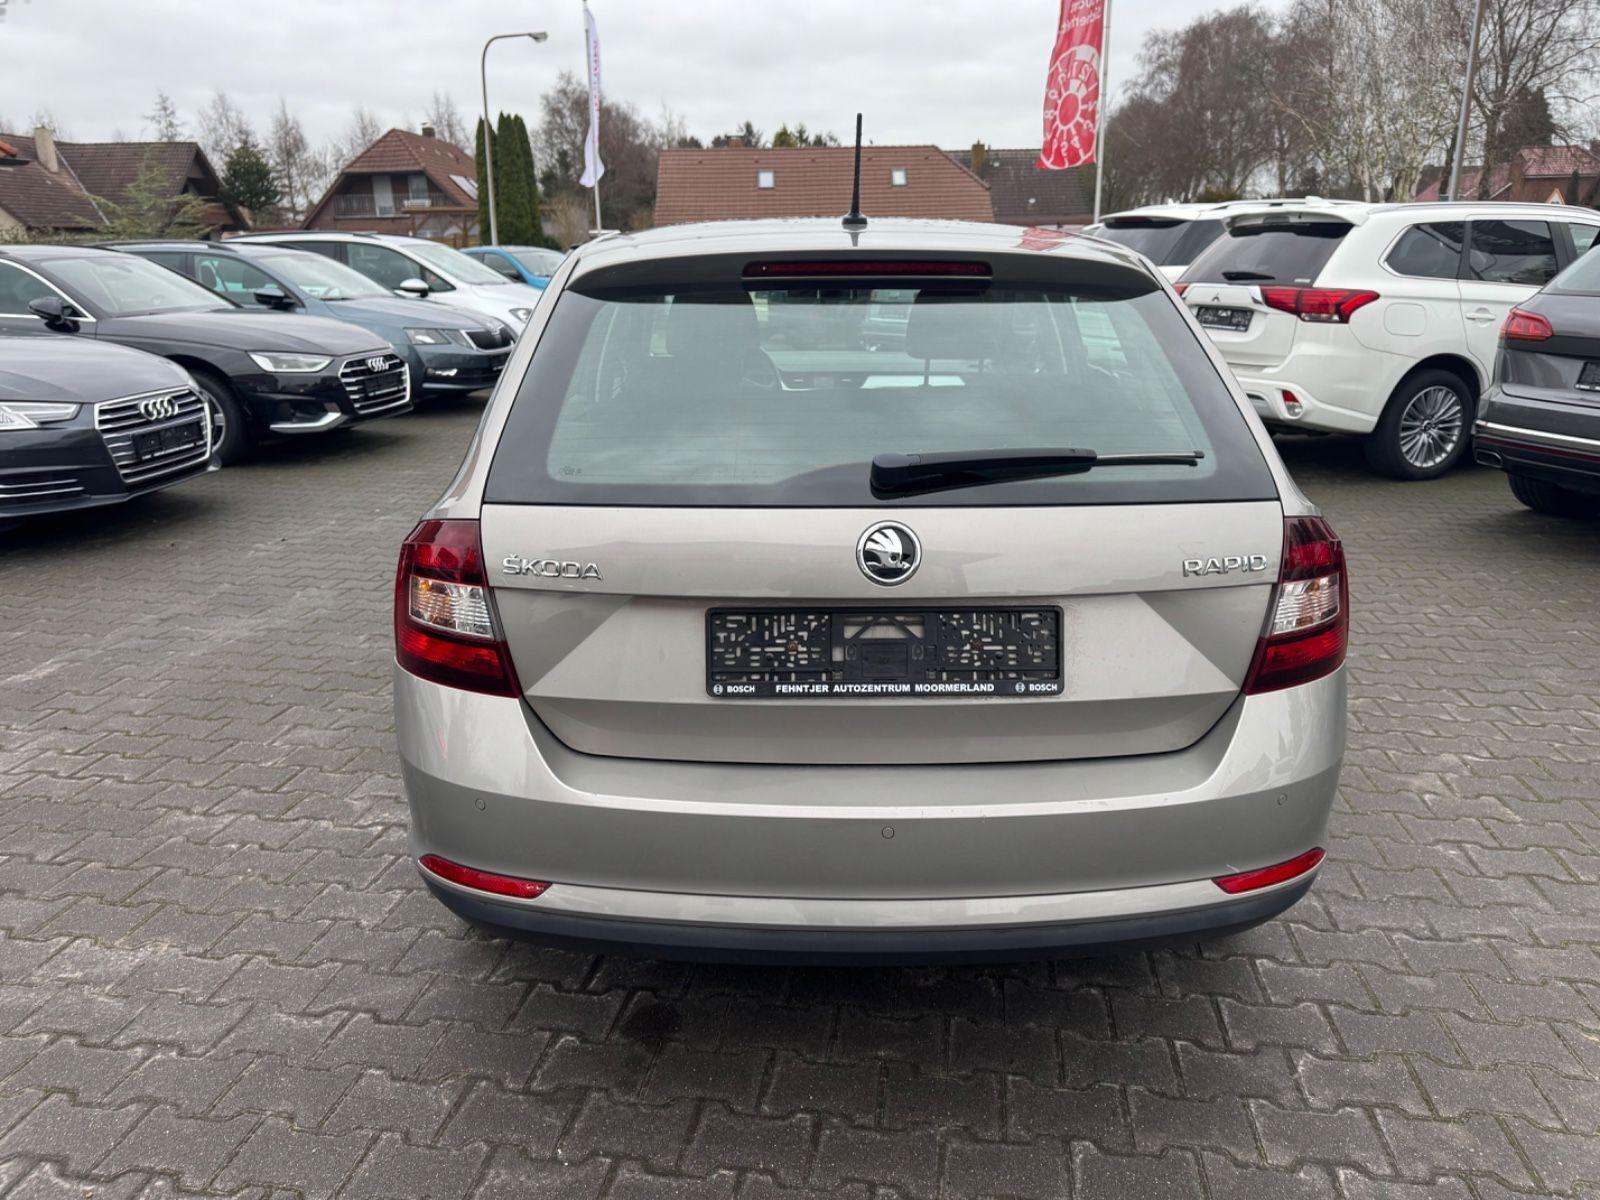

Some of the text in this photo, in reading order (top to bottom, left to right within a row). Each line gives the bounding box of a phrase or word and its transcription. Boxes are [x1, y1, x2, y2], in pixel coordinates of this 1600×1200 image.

[502, 553, 603, 580] ŠKODA
[1183, 554, 1267, 577] RAPID
[726, 685, 756, 694] BOSCH
[775, 683, 995, 693] FEHNTJER AUTOZENTRUM MOORMERLAND
[1029, 683, 1058, 692] BOSCH
